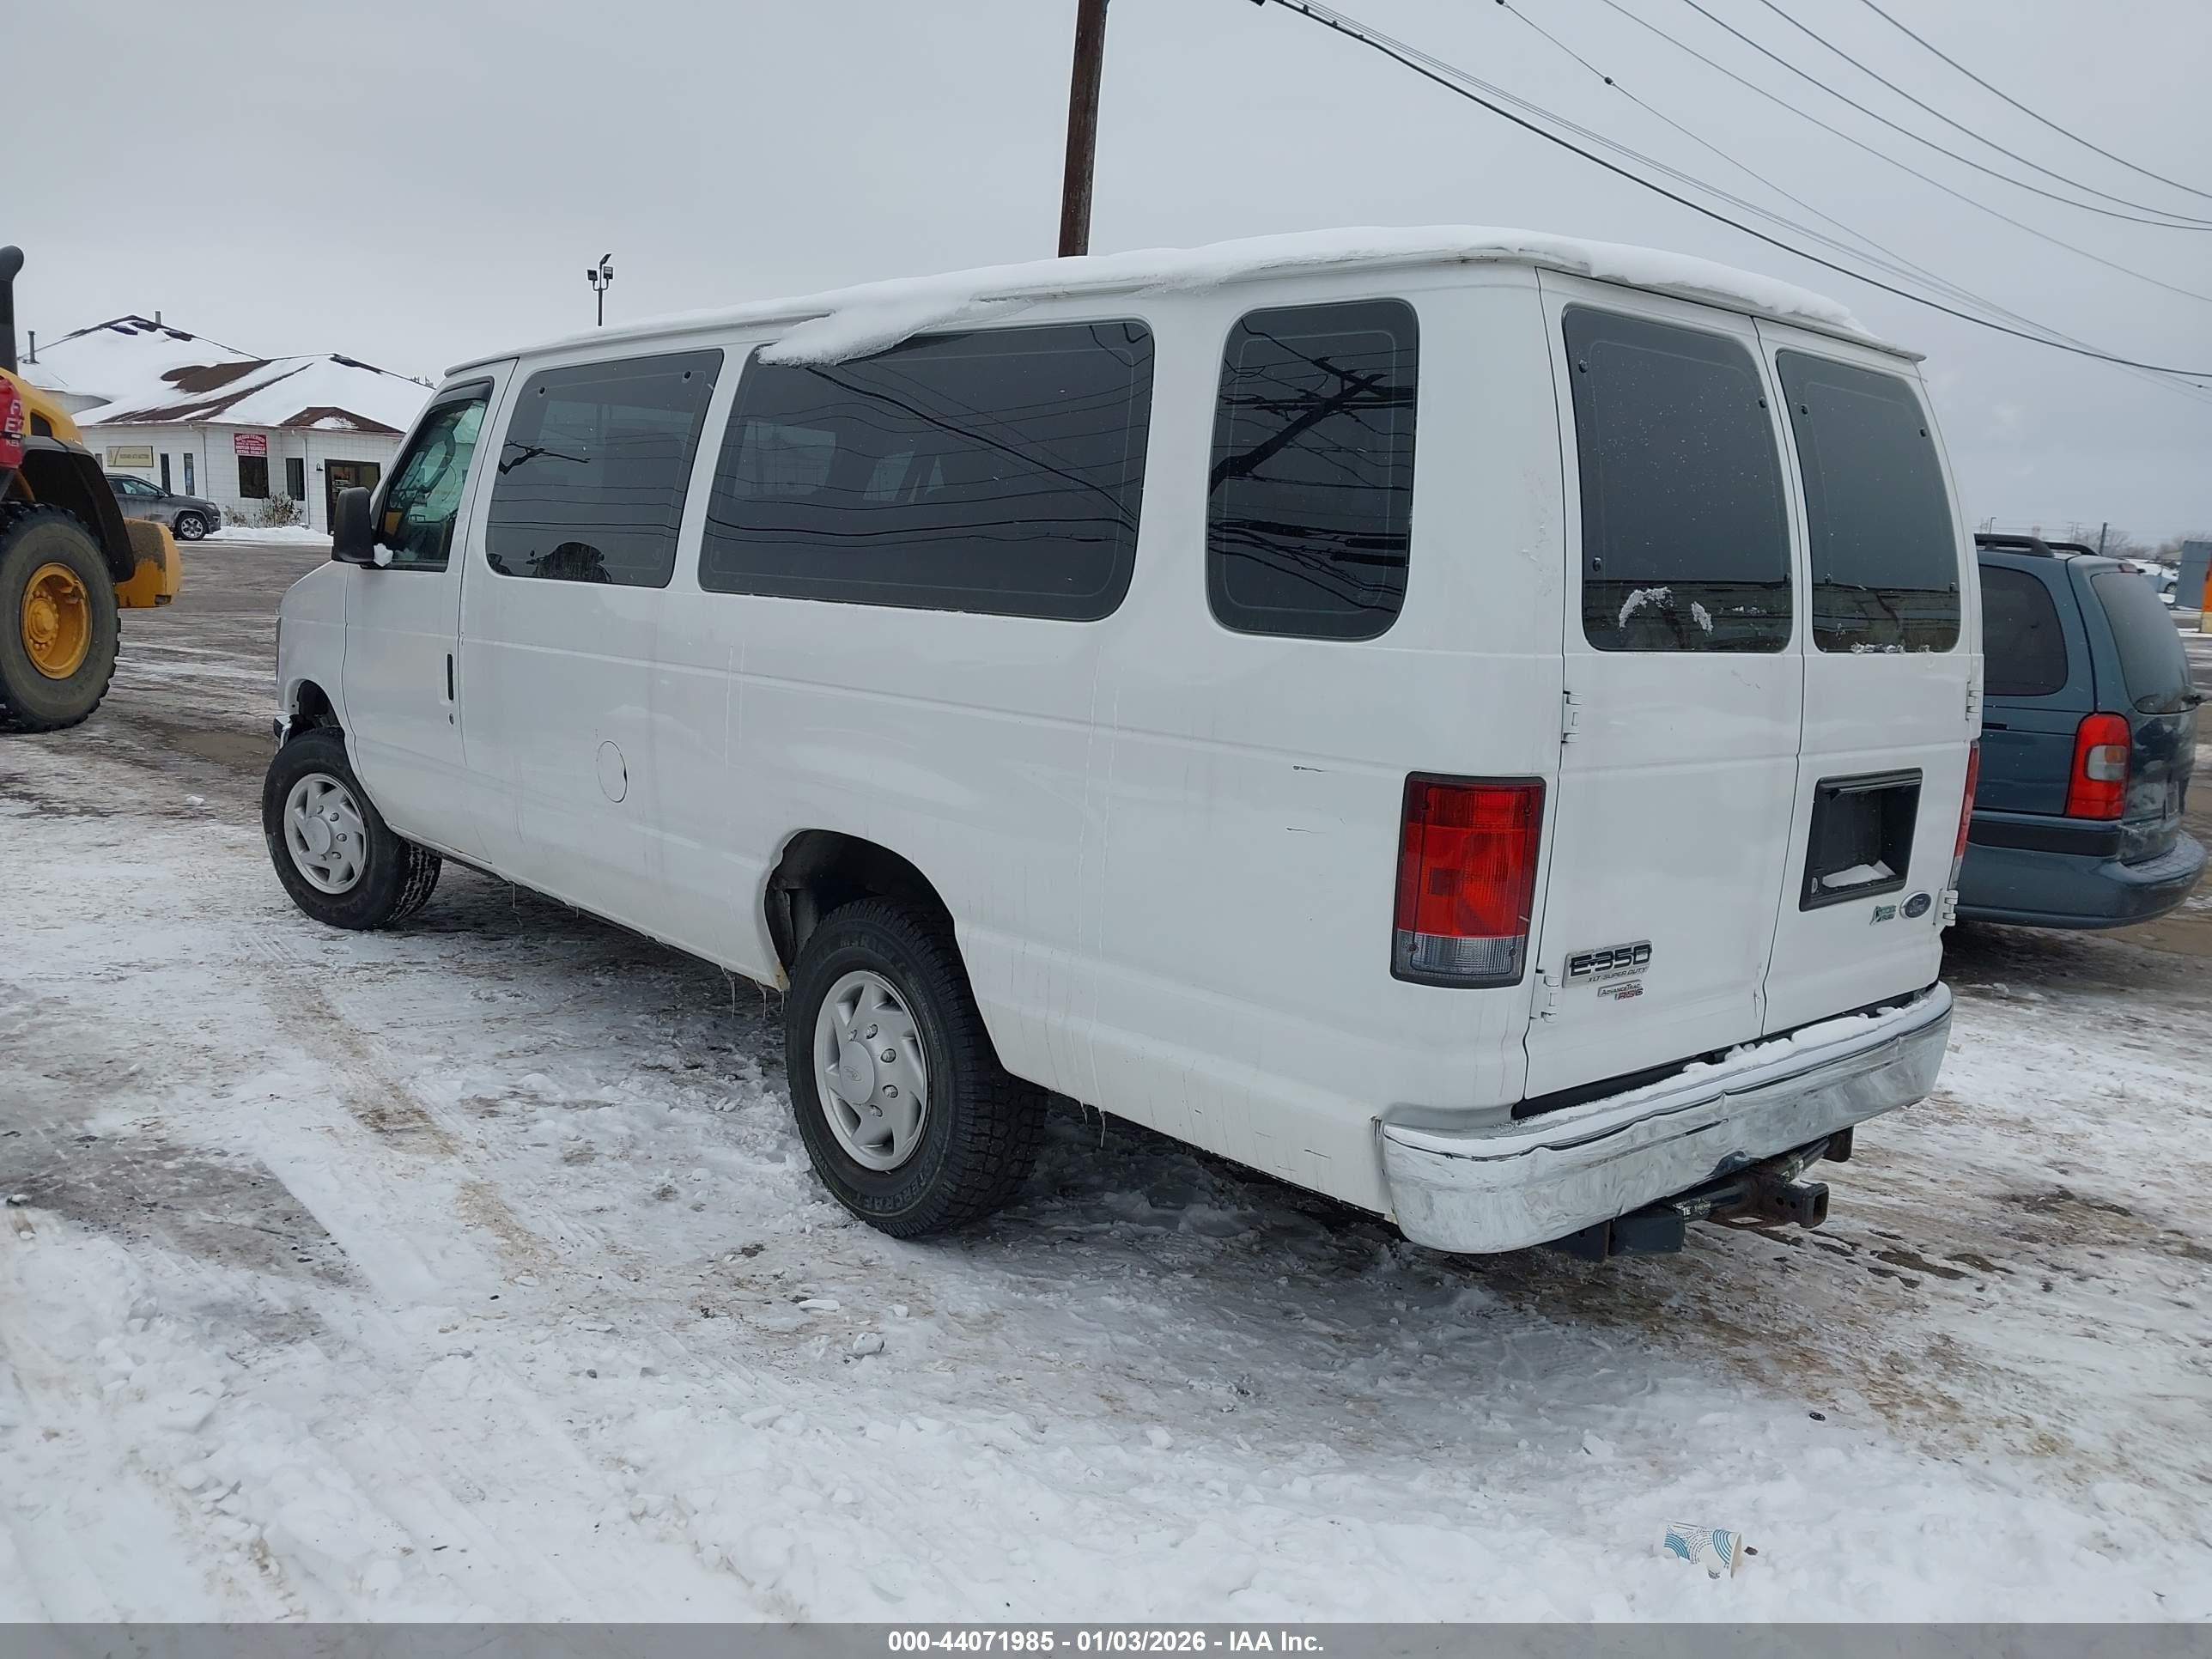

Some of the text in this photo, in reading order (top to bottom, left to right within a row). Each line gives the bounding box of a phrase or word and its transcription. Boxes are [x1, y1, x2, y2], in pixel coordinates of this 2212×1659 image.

[1570, 944, 1651, 977] E-350
[1602, 970, 1627, 981] SUPER
[1627, 966, 1648, 975] DUTY
